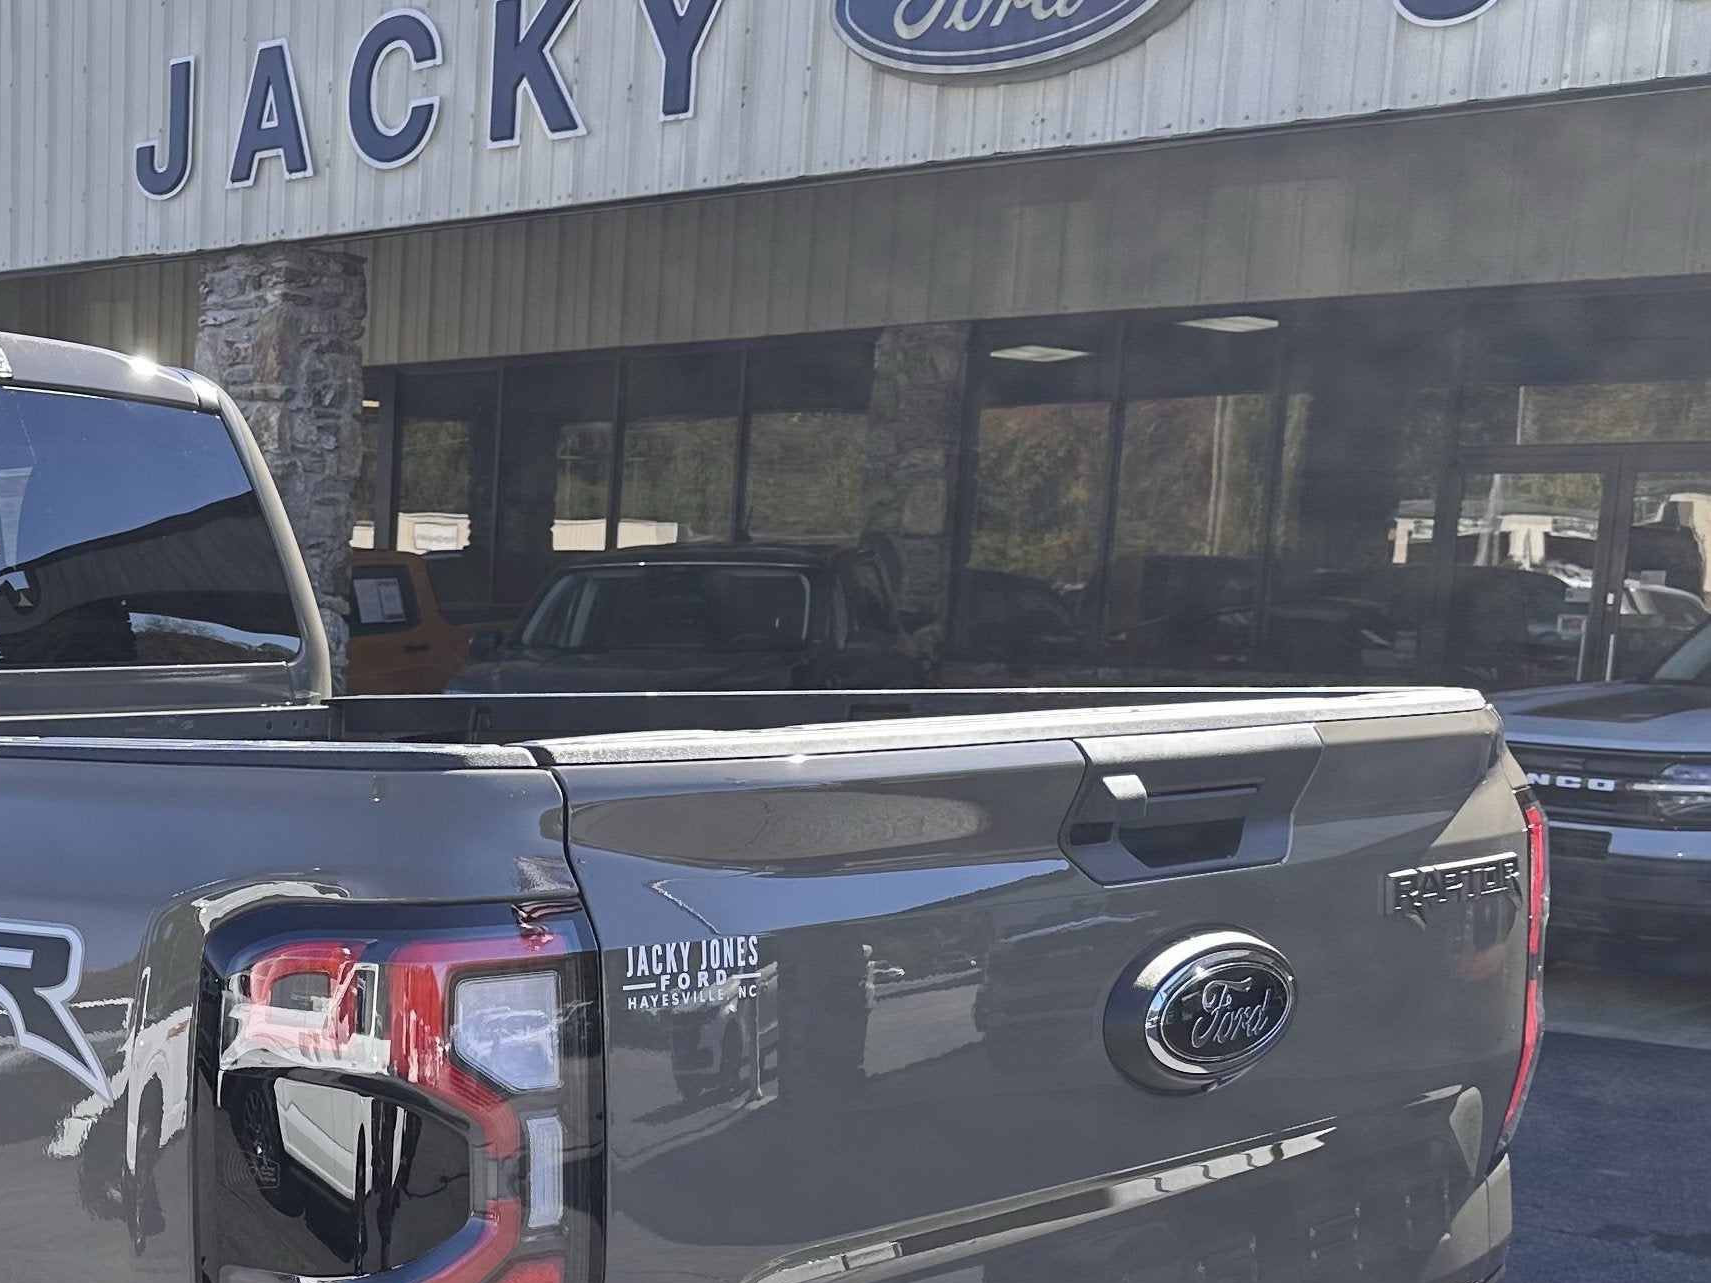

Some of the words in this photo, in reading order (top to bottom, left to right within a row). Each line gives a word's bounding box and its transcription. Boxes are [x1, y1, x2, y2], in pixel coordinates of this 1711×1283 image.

[135, 0, 721, 200] JACKY
[1384, 851, 1523, 931] RAPTOR
[626, 941, 691, 978] JACKY
[700, 935, 759, 970] JONES
[660, 969, 728, 992] FORD
[627, 988, 730, 1010] HAYESVILLE,
[739, 984, 758, 999] NC
[1191, 976, 1271, 1049] Ford
